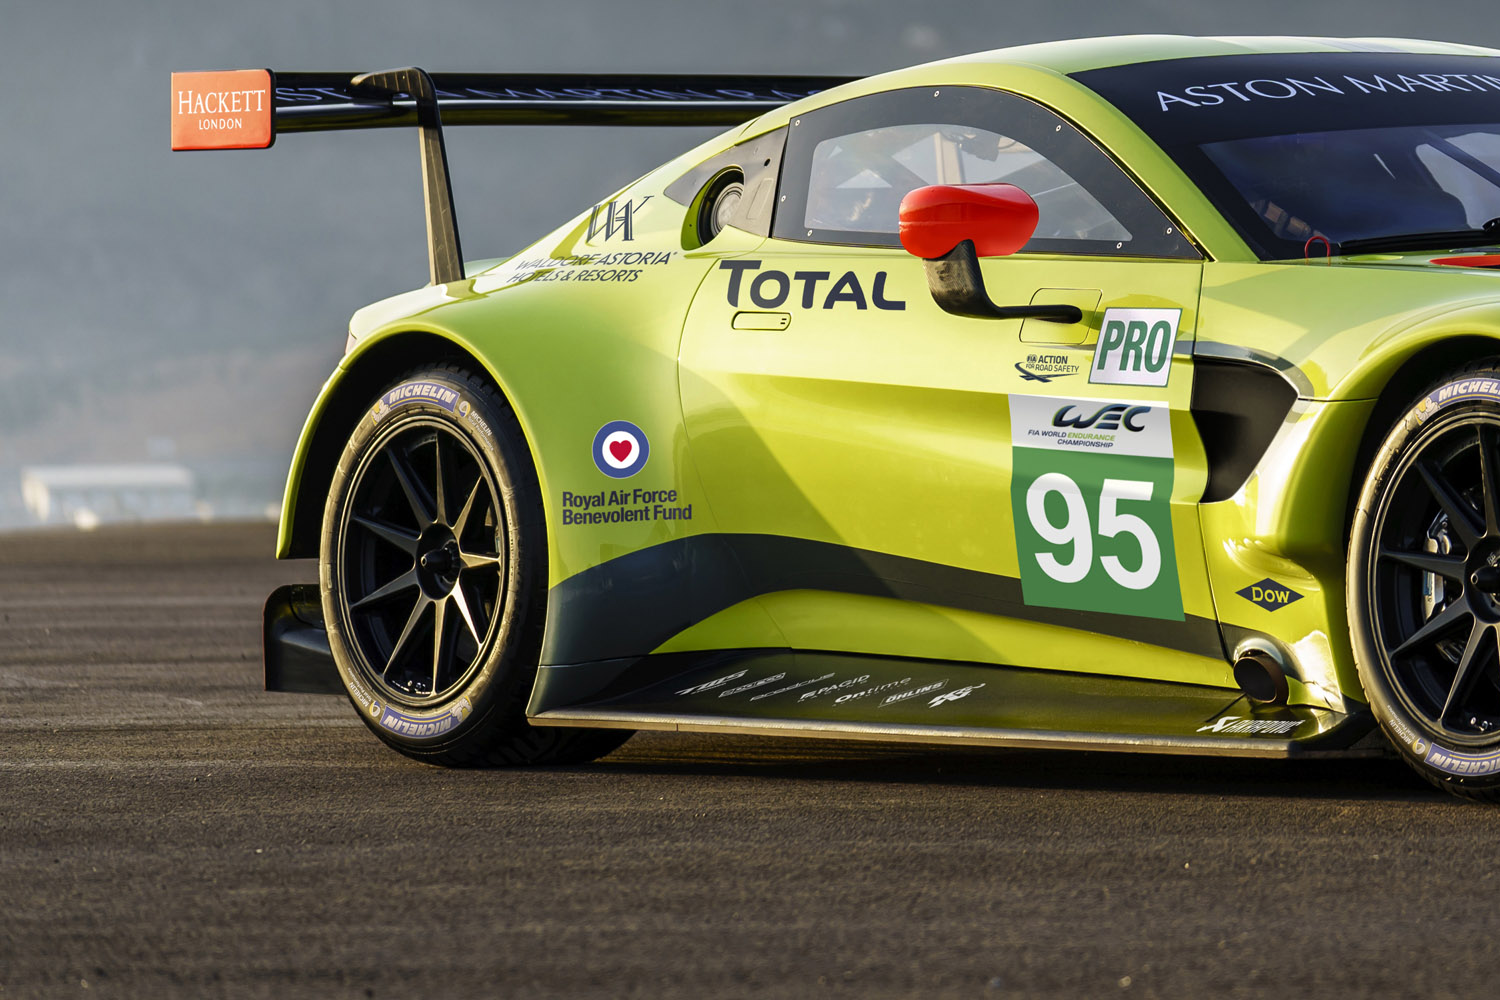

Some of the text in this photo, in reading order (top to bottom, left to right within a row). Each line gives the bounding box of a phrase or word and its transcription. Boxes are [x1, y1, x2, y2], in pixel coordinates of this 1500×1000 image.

[178, 89, 266, 114] HACKETT
[1157, 76, 1345, 111] ASTON
[198, 118, 242, 130] LONDON
[515, 255, 598, 271] WALDORF
[506, 269, 644, 283] HOTELS & RESORTS
[719, 260, 906, 311] TOTAL
[1096, 320, 1172, 373] PRO
[1035, 364, 1054, 372] ROAD
[1054, 365, 1079, 373] SAFETY
[1038, 355, 1068, 365] ACTION
[389, 384, 456, 404] MICHELIN
[470, 410, 493, 437] MICHELIN
[1052, 403, 1152, 433] WEC
[1028, 429, 1116, 442] FIA WORLD ENDURANCE
[1057, 438, 1114, 449] CHAMPIONSHIP
[562, 488, 677, 511] Royal Air Force
[562, 503, 692, 526] Benevolent Fund
[1026, 472, 1161, 590] 95
[1251, 586, 1290, 604] DOW
[384, 715, 451, 736] MICHELIN
